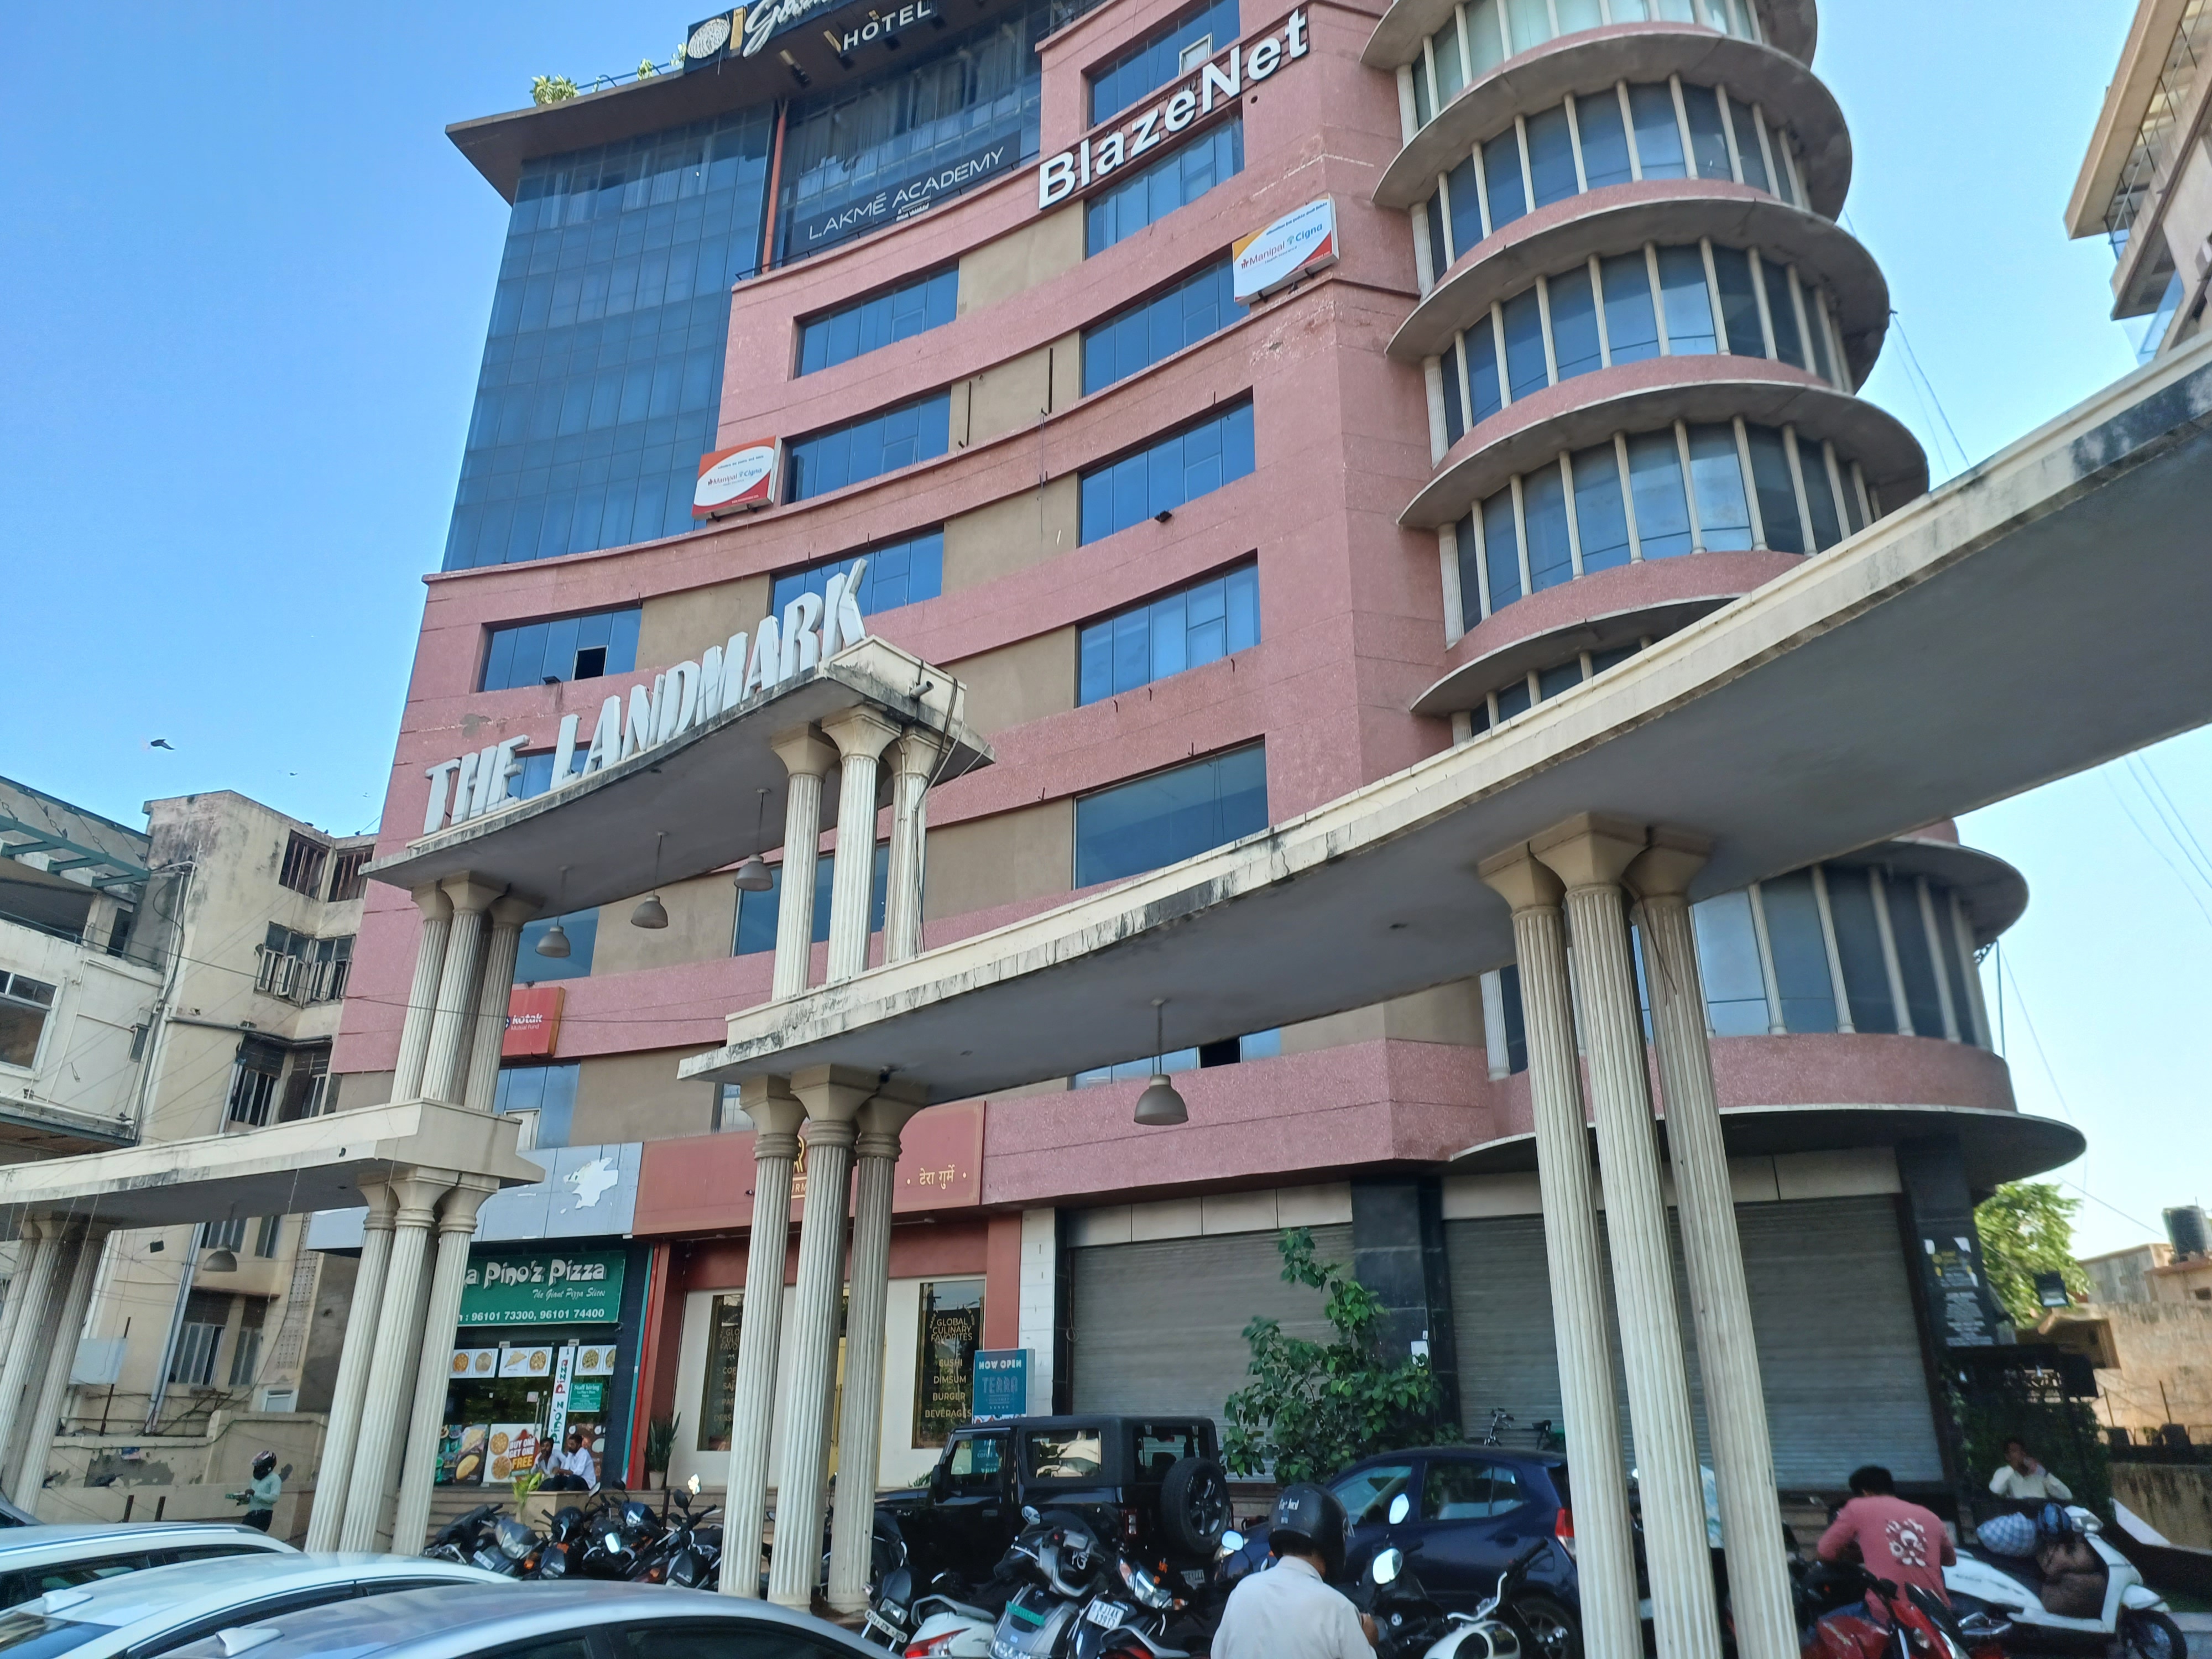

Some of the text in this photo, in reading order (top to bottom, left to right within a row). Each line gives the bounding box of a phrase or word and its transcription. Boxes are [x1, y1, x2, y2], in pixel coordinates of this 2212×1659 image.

[843, 1, 931, 51] HOTEL
[1039, 8, 1309, 210] BlazeNet
[809, 192, 886, 240] LAKMÉ
[892, 146, 1004, 208] ACADEMY
[1250, 241, 1285, 265] Manipal
[1296, 223, 1322, 242] Cigna
[423, 558, 868, 835] THE LANDMARK
[513, 1013, 542, 1024] kotak
[920, 1164, 955, 1190] टेरा गुर्मे
[483, 1260, 545, 1289] Pino'z
[549, 1259, 607, 1287] Pizza
[533, 1287, 606, 1300] The Giant Pizza Slices
[472, 1311, 500, 1321] 96101
[504, 1311, 536, 1321] 73300,
[540, 1310, 569, 1319] 96101
[573, 1308, 604, 1318] 74400
[937, 1317, 968, 1326] GLOBAL
[726, 1328, 740, 1337] GLO
[933, 1325, 972, 1334] CULINARY
[931, 1333, 972, 1342] FAVORITES
[722, 1366, 737, 1375] COF
[979, 1359, 1021, 1370] NOW OPEN
[555, 1359, 568, 1394] Pizza
[933, 1375, 966, 1384] DIMSUM
[982, 1376, 1018, 1394] TERRA
[933, 1392, 966, 1401] BURGER
[510, 1438, 535, 1449] BUY ONE
[509, 1446, 534, 1459] GET ONE
[512, 1455, 533, 1469] FREE
